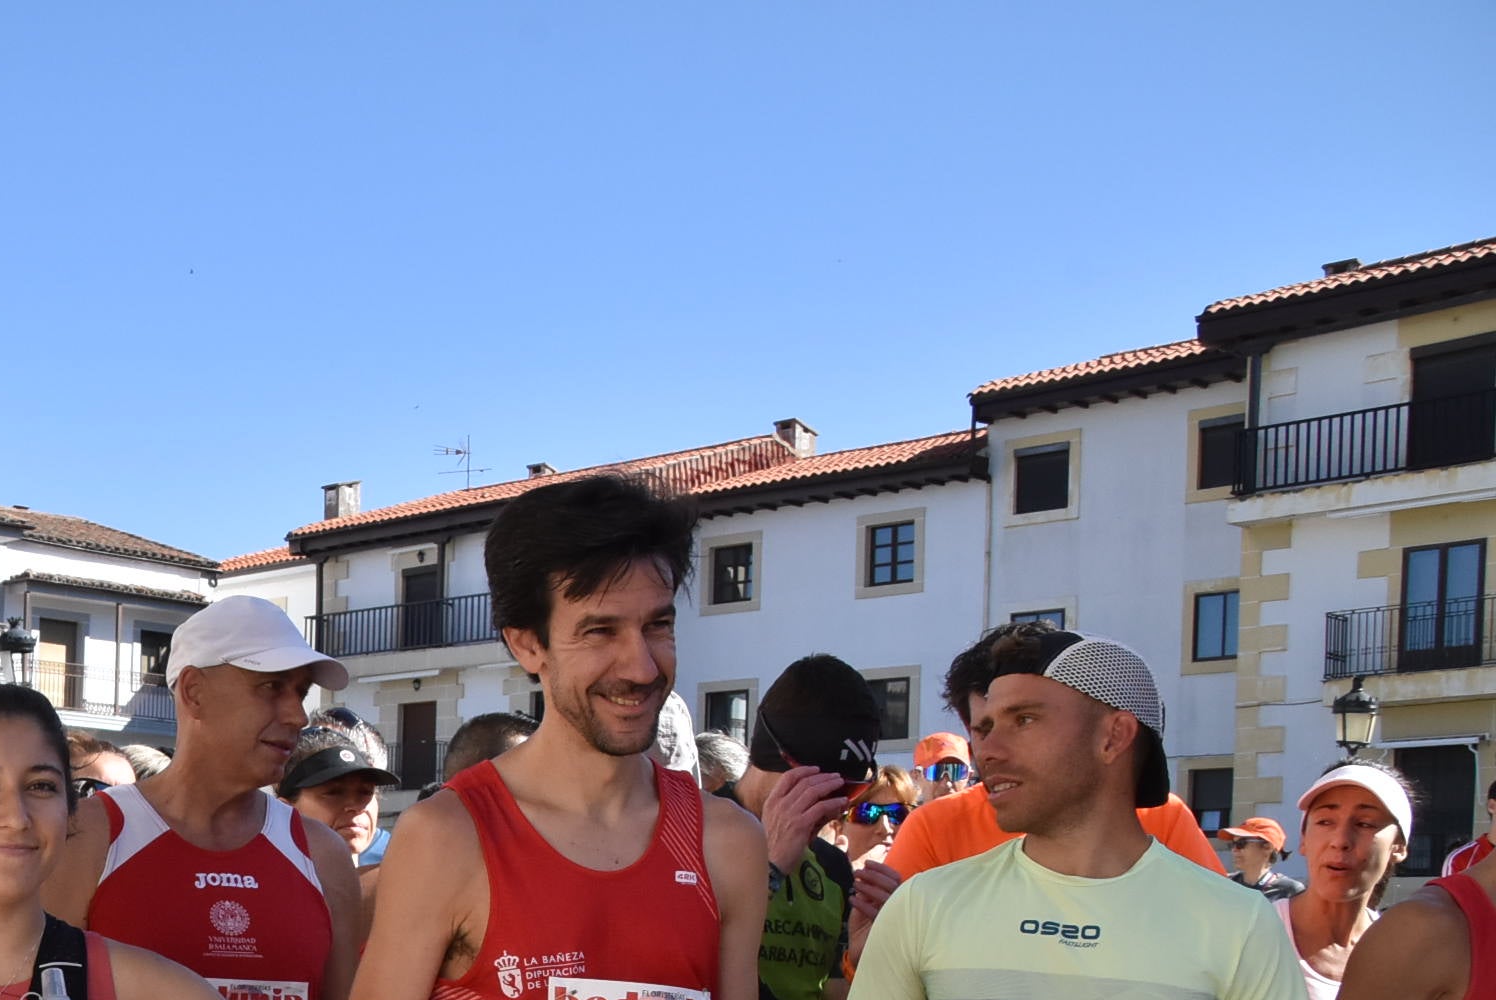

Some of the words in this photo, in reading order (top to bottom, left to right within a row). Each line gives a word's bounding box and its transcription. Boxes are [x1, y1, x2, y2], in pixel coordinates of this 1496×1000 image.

[524, 957, 537, 967] LA
[542, 951, 585, 964] BAÑEZA
[525, 964, 585, 980] DIPUTACIÓN
[527, 979, 542, 990] DE
